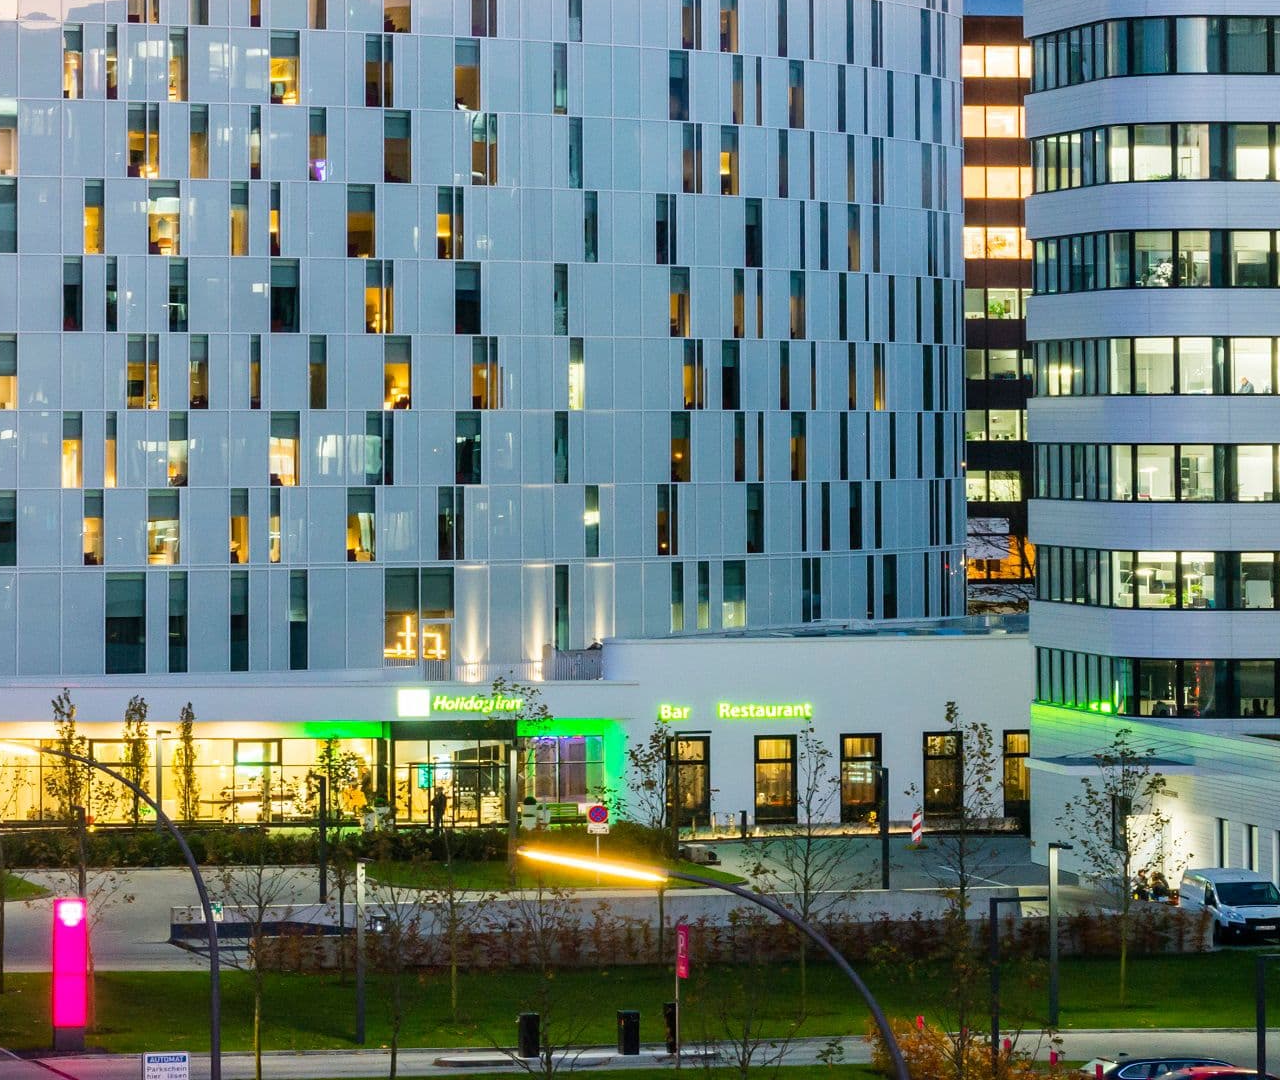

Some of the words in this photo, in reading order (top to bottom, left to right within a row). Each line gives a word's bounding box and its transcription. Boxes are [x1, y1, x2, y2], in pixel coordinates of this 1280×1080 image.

[433, 695, 494, 713] Holiday
[660, 704, 689, 719] Bar
[719, 702, 812, 718] Restaurant
